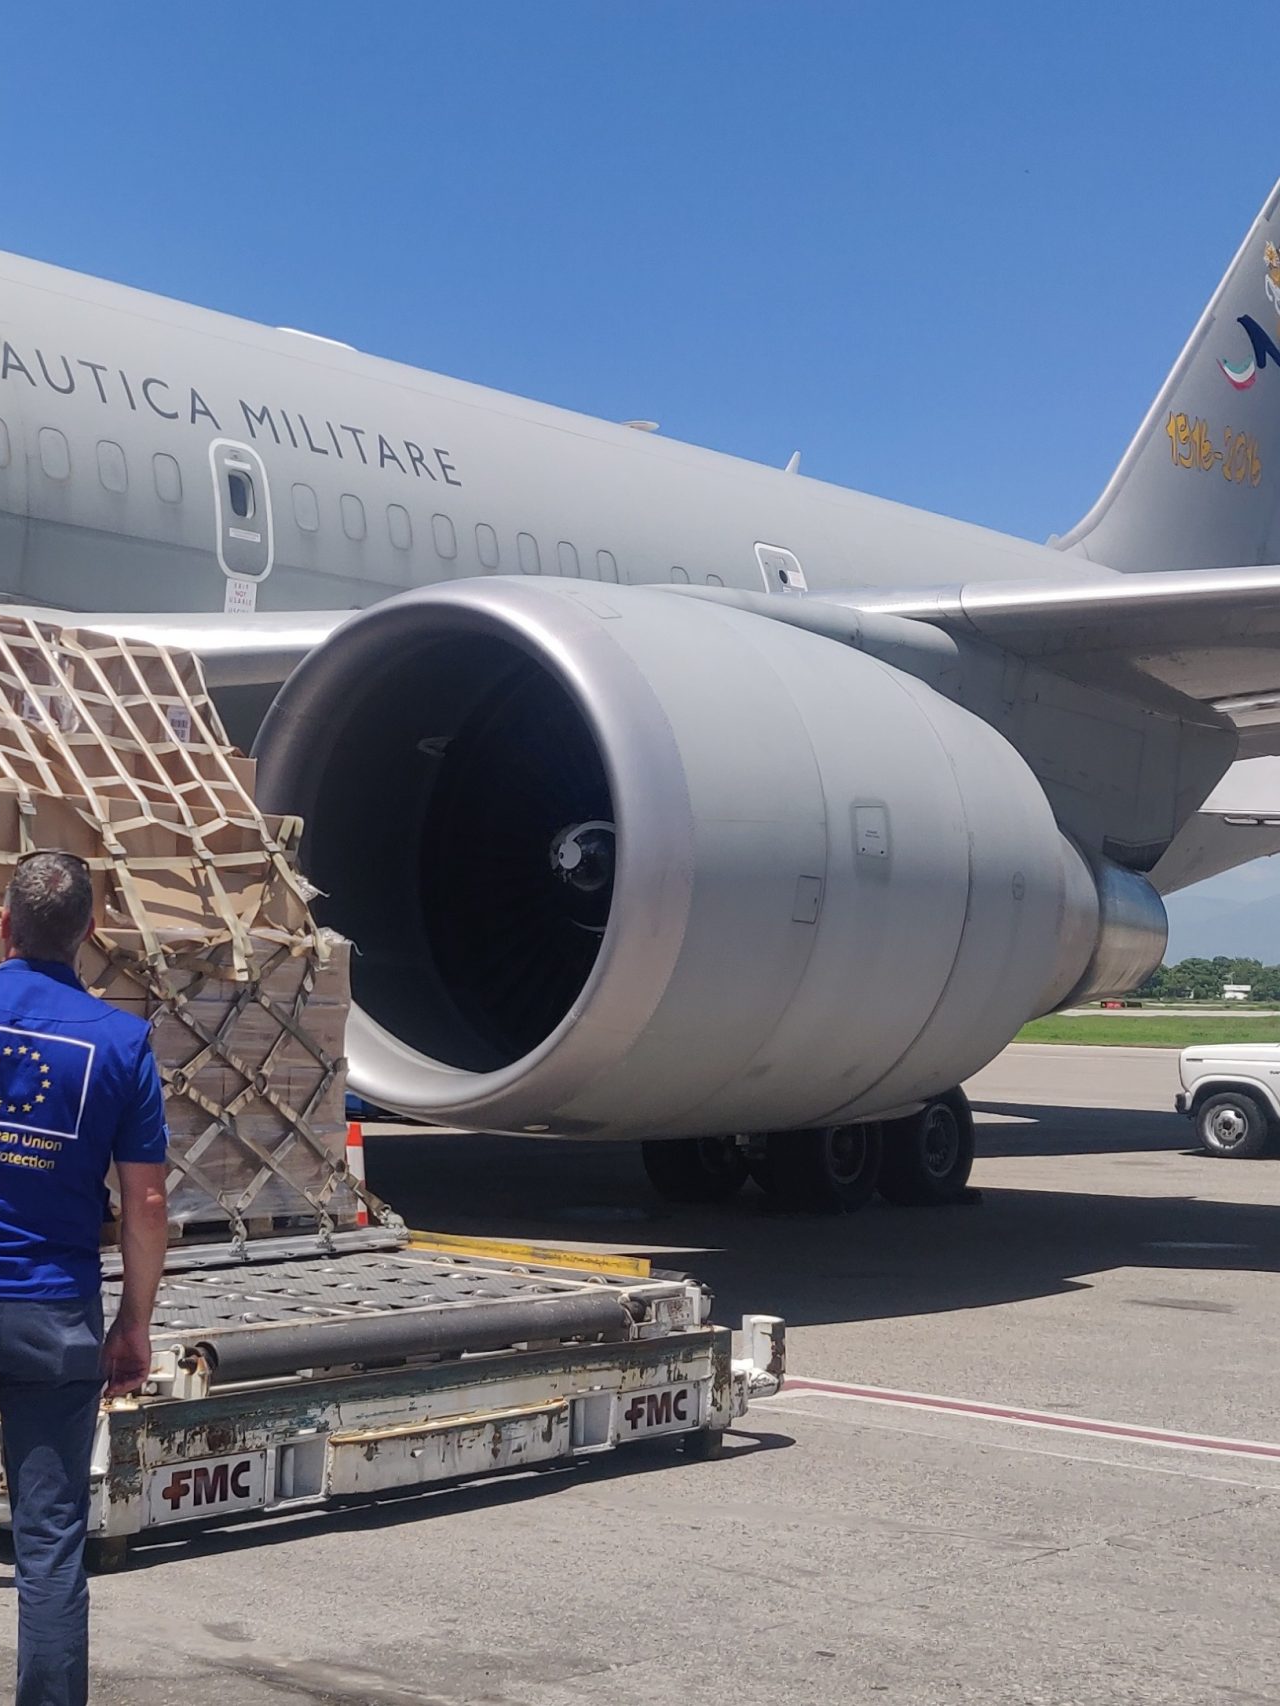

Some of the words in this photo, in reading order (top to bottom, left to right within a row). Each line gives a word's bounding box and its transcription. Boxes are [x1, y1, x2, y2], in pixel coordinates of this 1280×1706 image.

[238, 399, 462, 487] MILITARE
[22, 1133, 62, 1152] Union
[624, 1388, 688, 1430] FMC
[161, 1460, 251, 1511] FMC
